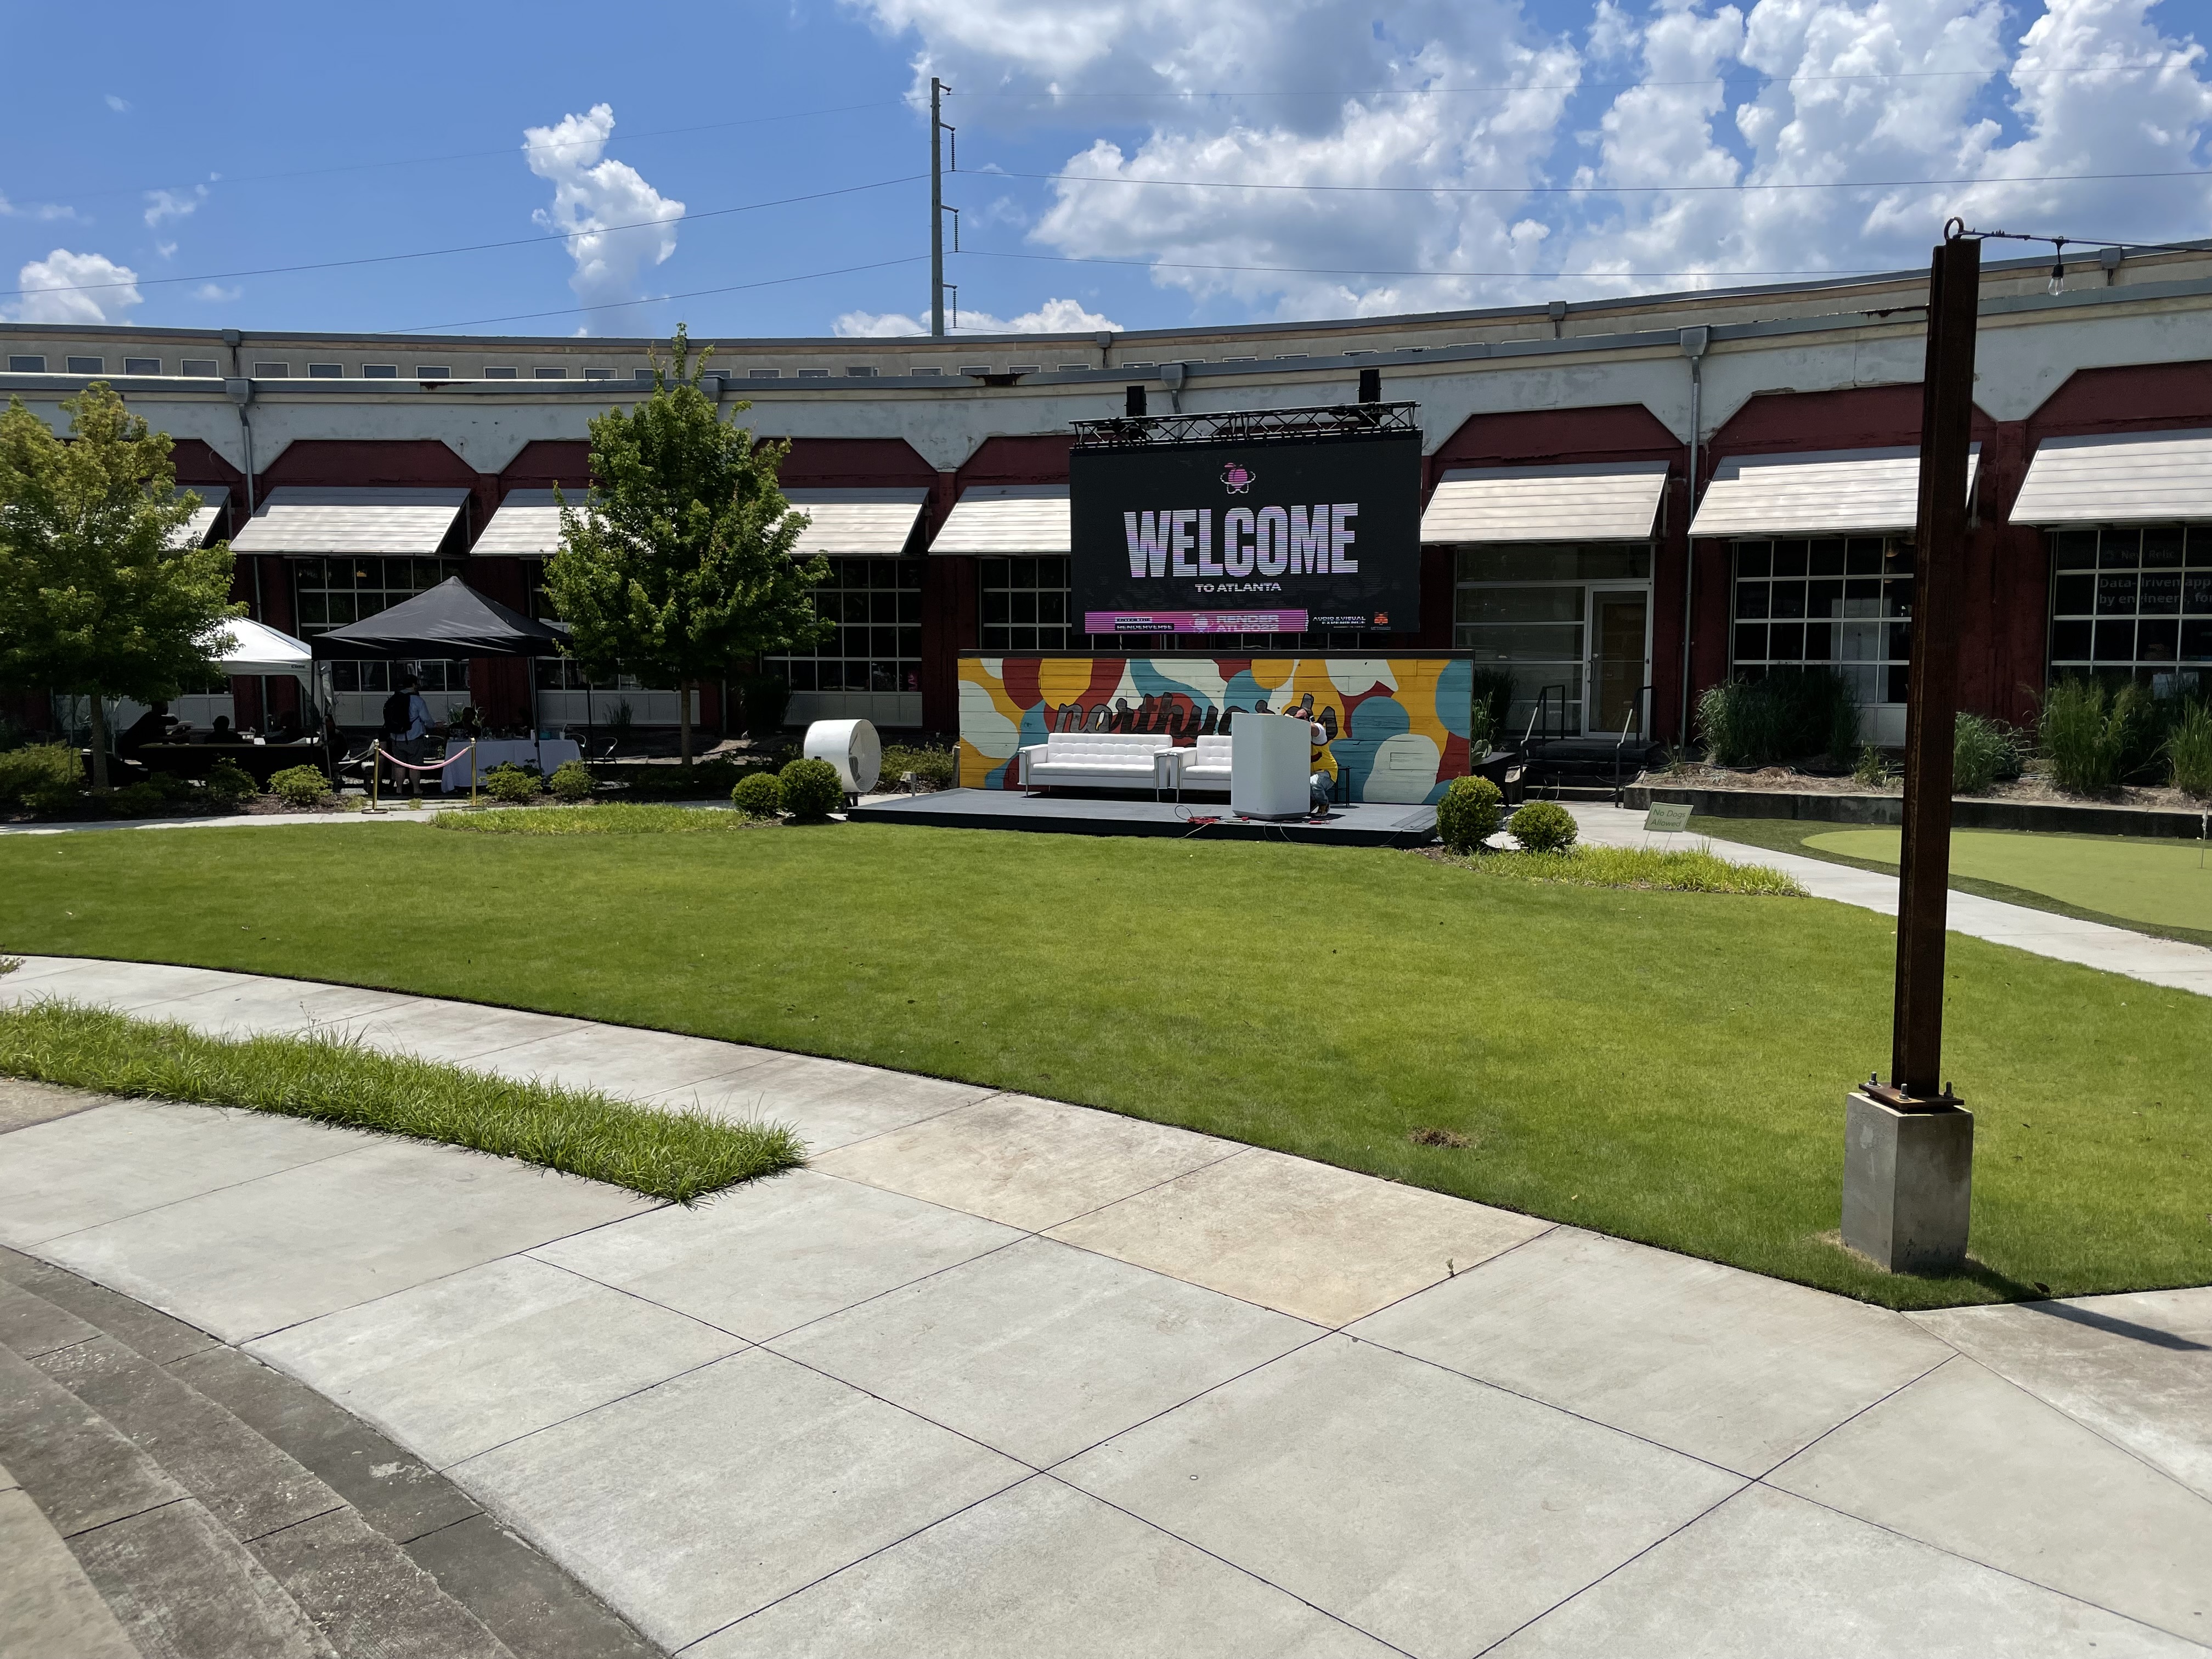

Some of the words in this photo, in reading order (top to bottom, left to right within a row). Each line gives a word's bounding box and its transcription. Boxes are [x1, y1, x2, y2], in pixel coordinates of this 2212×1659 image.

[1122, 503, 1359, 578] WELCOME
[2148, 549, 2176, 559] Relic
[1195, 583, 1215, 593] TO
[1216, 582, 1282, 592] ATLANTA
[2185, 578, 2212, 590] app
[2099, 594, 2115, 606] by
[1216, 614, 1279, 624] RENDER
[1653, 808, 1664, 816] No
[1666, 810, 1686, 820] Dogs
[1650, 819, 1682, 827] Allowed
